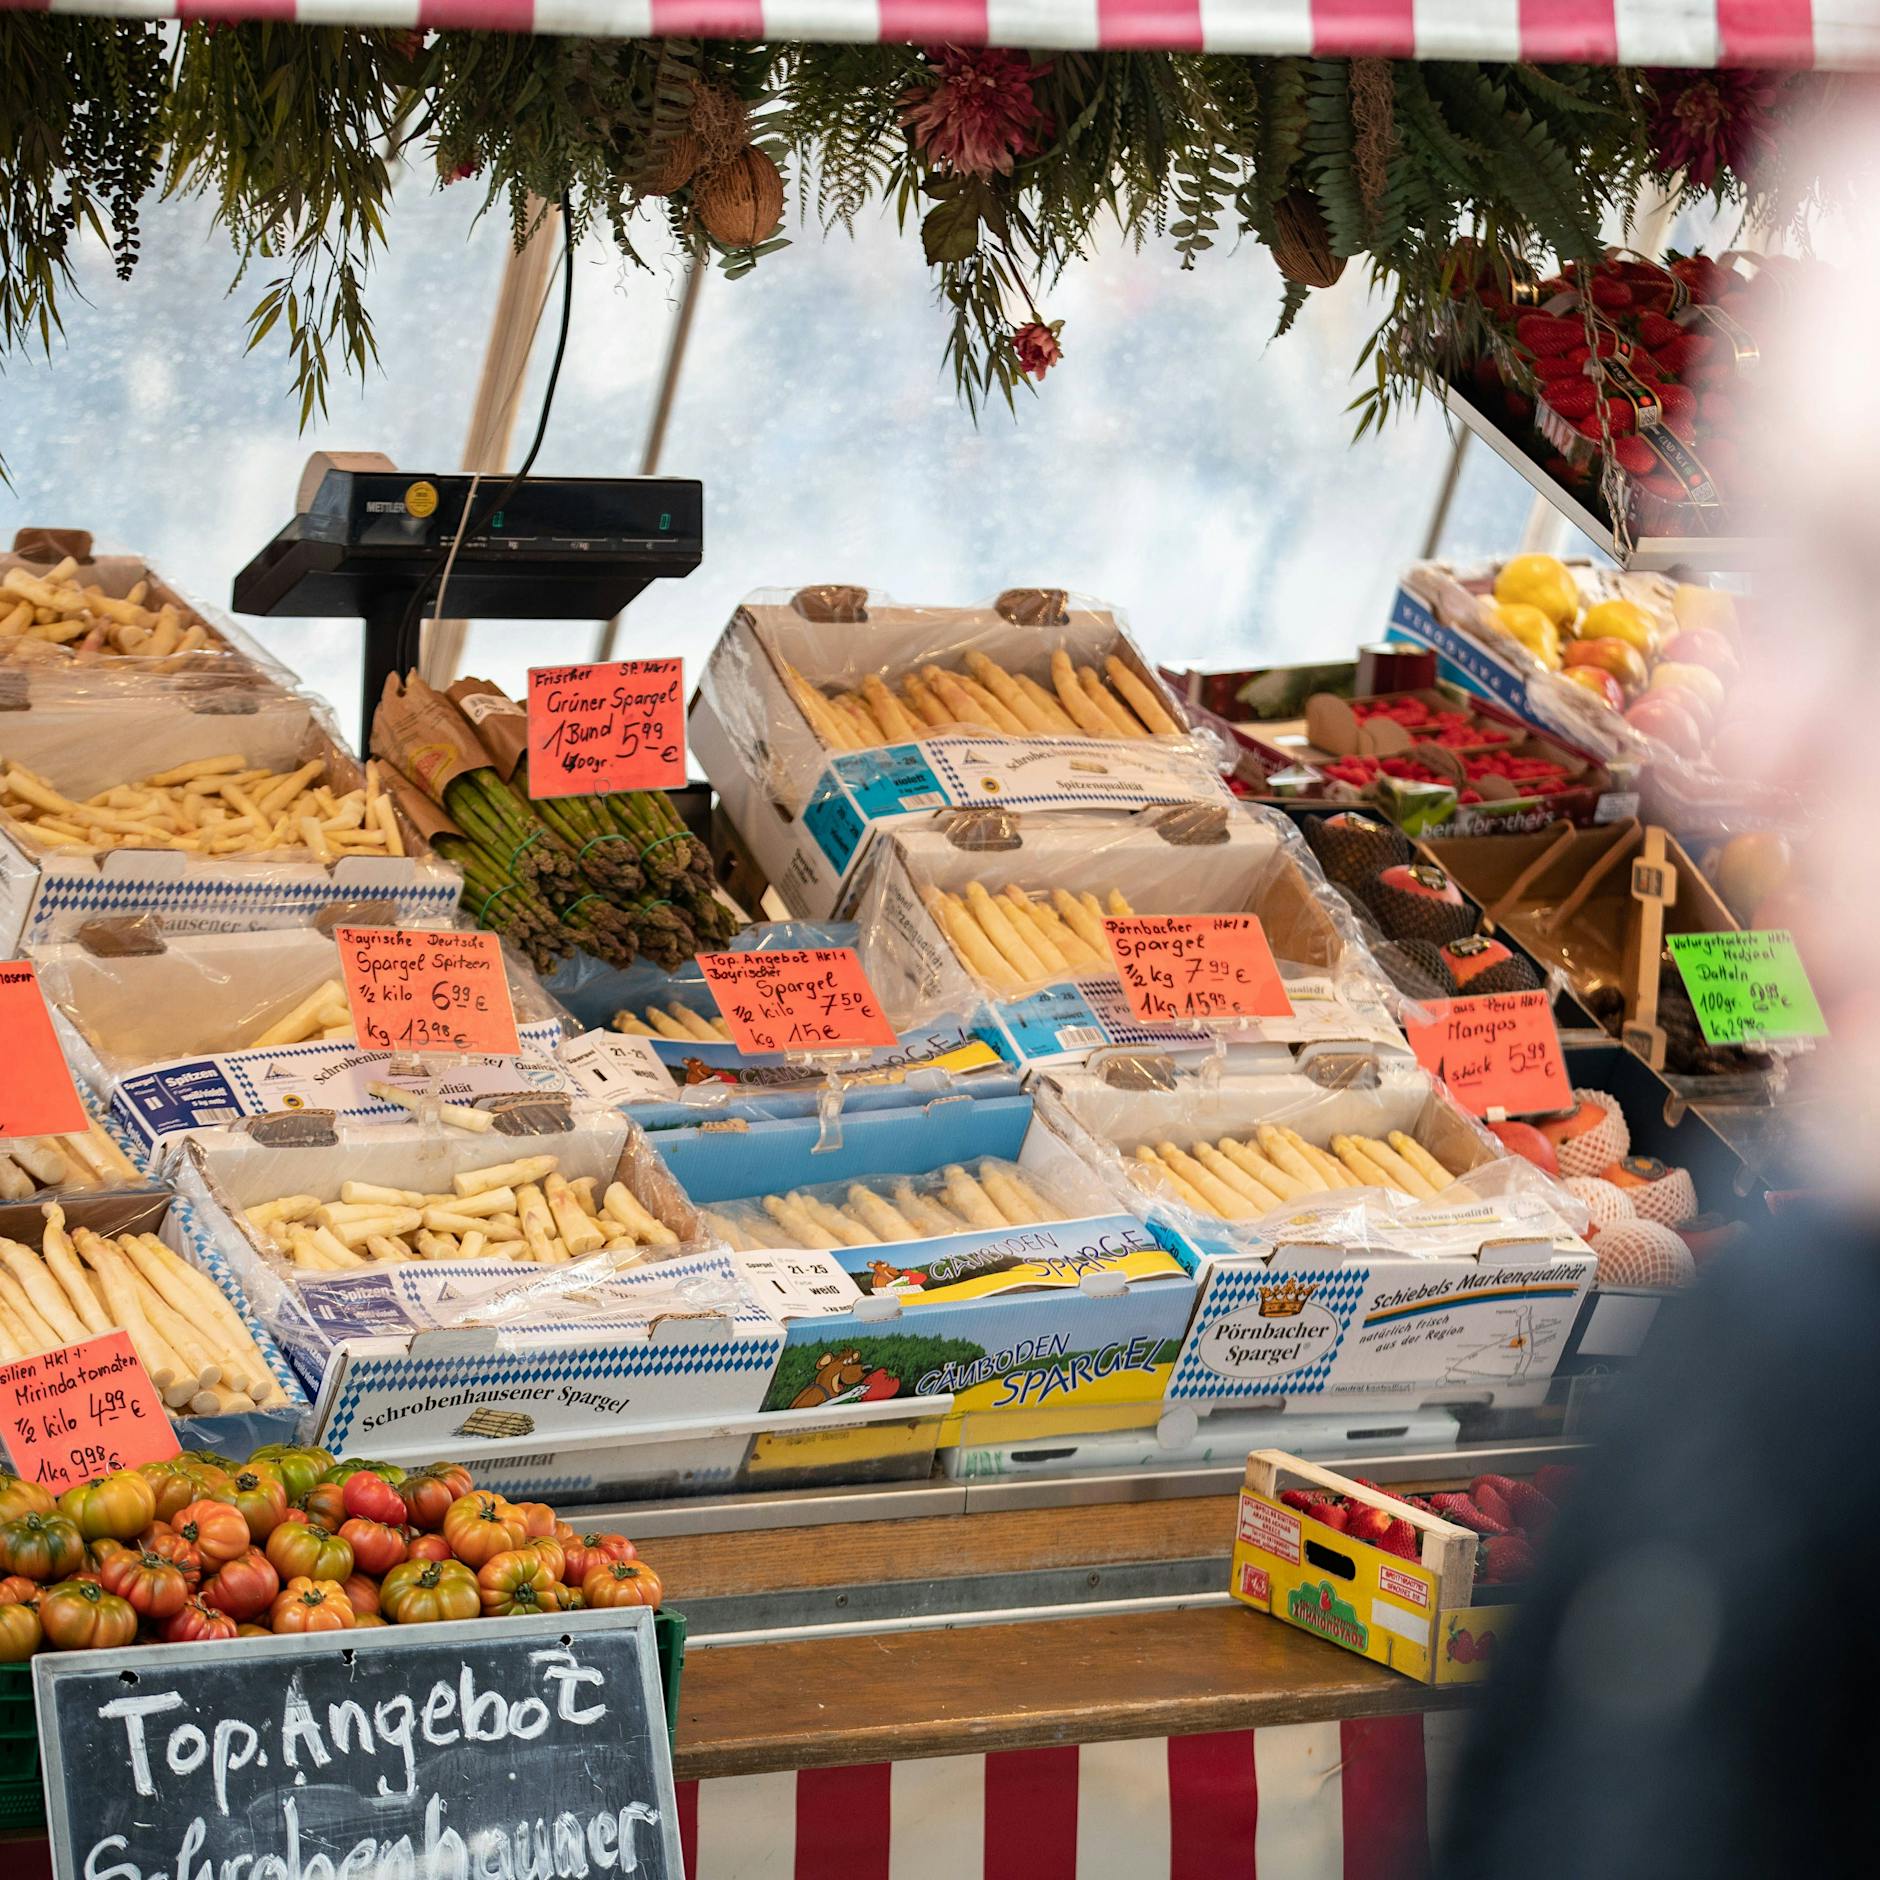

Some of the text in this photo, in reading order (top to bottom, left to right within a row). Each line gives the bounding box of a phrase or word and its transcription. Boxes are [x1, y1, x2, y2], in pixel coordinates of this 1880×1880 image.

[547, 690, 607, 713] Grüner
[610, 681, 678, 717] Spargel
[543, 720, 566, 757] 1
[565, 713, 613, 745] Bund
[660, 745, 679, 762] €
[1056, 779, 1145, 792] Spitzenqualität
[1116, 934, 1205, 958] Spargel
[357, 951, 490, 984] Spargel Spitzen
[744, 951, 809, 968] Angebot
[1696, 963, 1749, 981] Datteln
[756, 972, 838, 1004] Spargel
[1150, 965, 1175, 988] kg
[1236, 968, 1252, 983] €
[383, 985, 412, 1001] kilo
[475, 995, 488, 1011] €
[759, 1001, 794, 1019] kilo
[862, 1005, 875, 1018] €
[1453, 1003, 1475, 1014] aus
[367, 1017, 390, 1047] kg
[750, 1028, 775, 1048] kg
[1448, 1019, 1516, 1043] Mangos
[165, 1069, 219, 1087] Spitzen
[340, 1286, 391, 1303] Spitzen
[1370, 1263, 1588, 1312] Schiebels Markenqualität
[1214, 1321, 1330, 1341] Pörnbacher
[1358, 1314, 1450, 1344] natürlich frisch
[1375, 1326, 1465, 1353] aus der Region
[915, 1332, 1071, 1397] GÄUBODEN
[1225, 1343, 1301, 1366] Spargel
[993, 1335, 1166, 1407] SPARGEL
[43, 1408, 77, 1439] kilo
[131, 1399, 146, 1418] €
[362, 1385, 630, 1433] Schrobenhausener Spargel
[99, 1648, 606, 1816] Top. Angebot
